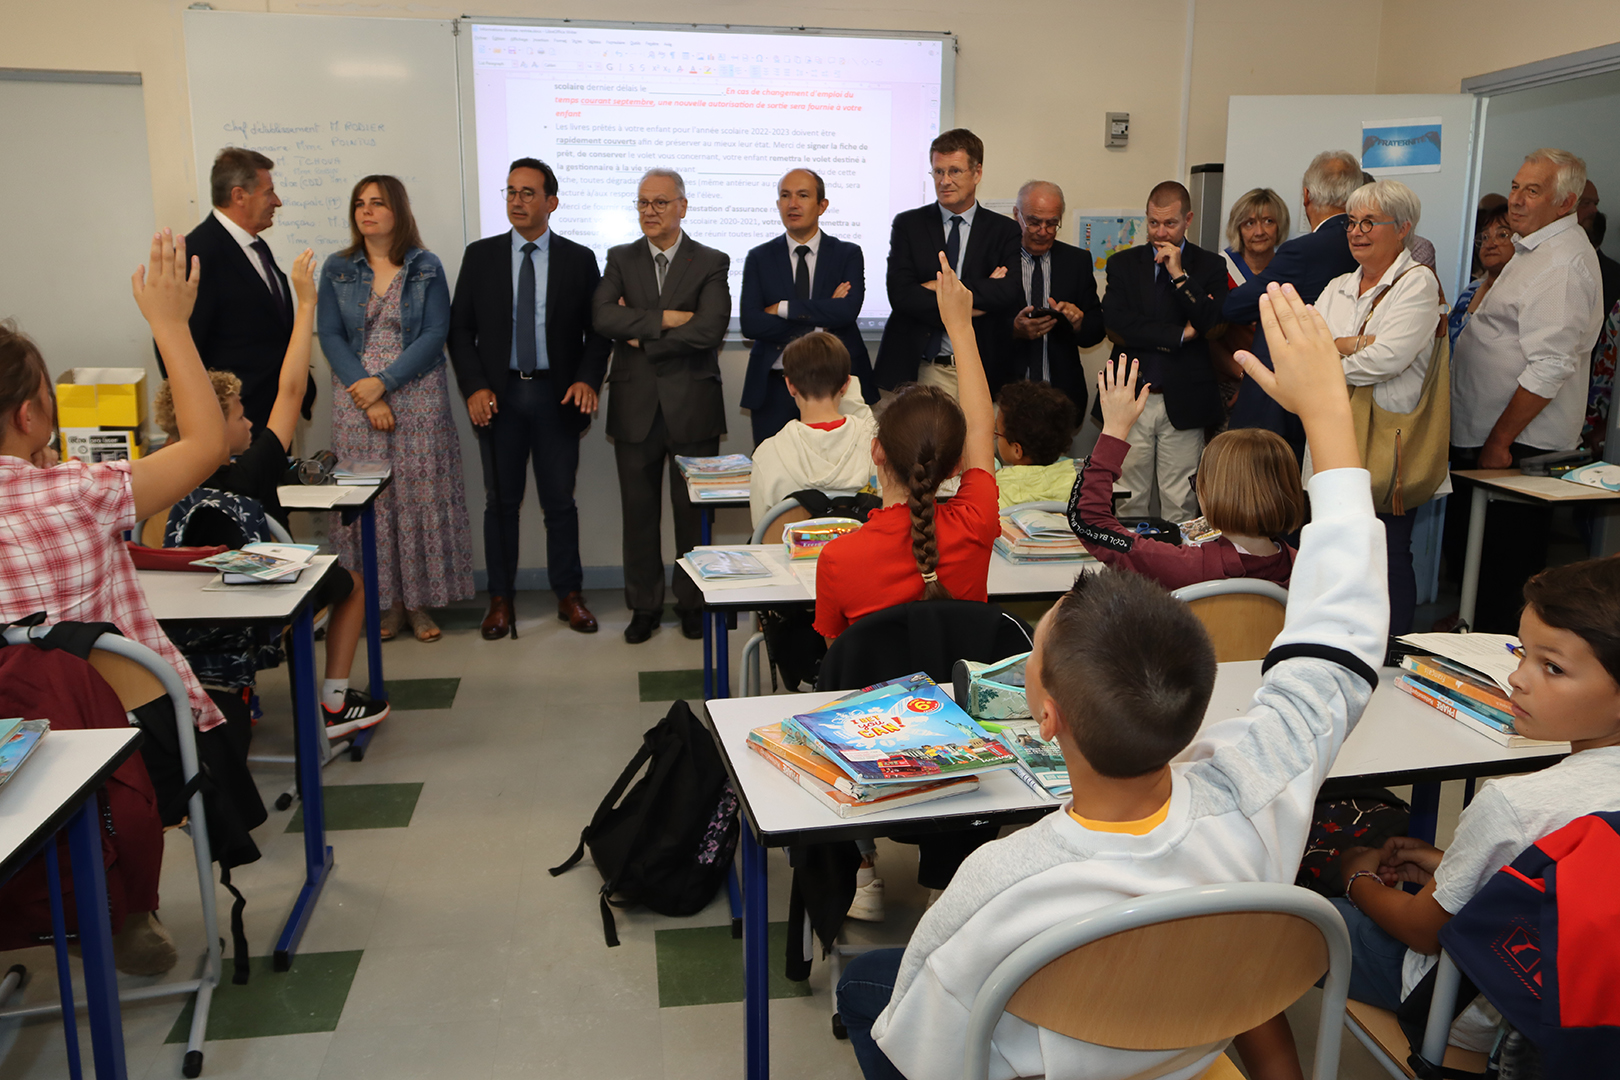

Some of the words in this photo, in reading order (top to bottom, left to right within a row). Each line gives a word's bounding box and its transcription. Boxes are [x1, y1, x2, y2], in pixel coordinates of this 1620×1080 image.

[554, 82, 585, 91] scolaire
[586, 83, 615, 92] dernier
[616, 83, 638, 92] délais
[639, 84, 647, 92] le
[726, 87, 735, 95] En
[751, 88, 761, 96] de
[762, 89, 809, 98] changement
[810, 90, 843, 99] d'emploi
[844, 91, 854, 99] du
[555, 97, 579, 105] temps
[581, 97, 611, 105] courant
[613, 97, 656, 107] septembre,
[674, 99, 707, 107] nouvelle
[708, 100, 754, 109] autorisation
[755, 101, 765, 109] de
[767, 101, 789, 109] sortie
[807, 102, 835, 112] fournie
[836, 103, 841, 111] à
[842, 104, 862, 112] votre
[555, 110, 582, 118] enfant
[555, 123, 569, 131] Les
[569, 123, 590, 132] livres
[591, 124, 616, 133] prêtés
[617, 124, 623, 132] à
[624, 125, 645, 133] votre
[646, 124, 671, 133] enfant
[672, 126, 691, 135] pour
[691, 126, 719, 135] l'année
[721, 127, 750, 135] scolaire
[751, 127, 790, 136] 2022-2023
[791, 128, 819, 137] doivent
[820, 128, 836, 137] être
[556, 137, 602, 145] rapidement
[603, 137, 637, 145] couverts
[638, 138, 652, 146] afin
[654, 138, 664, 146] de
[665, 139, 701, 148] préserver
[713, 140, 737, 148] mieux
[738, 140, 753, 148] leur
[773, 141, 794, 149] Merci
[796, 142, 806, 150] de
[807, 142, 829, 151] signer
[830, 142, 838, 150] la
[839, 142, 858, 150] fiche
[858, 143, 868, 151] de
[556, 149, 575, 159] prêt,
[576, 150, 587, 158] de
[628, 151, 635, 159] le
[636, 151, 656, 159] volet
[676, 153, 721, 161] concernant,
[744, 153, 768, 162] enfant
[769, 154, 802, 163] remettra
[803, 155, 811, 163] le
[812, 155, 831, 164] volet
[832, 155, 860, 164] destiné
[861, 156, 866, 164] à
[556, 162, 564, 170] la
[565, 163, 614, 172] gestionnaire
[615, 163, 620, 171] à
[621, 163, 629, 171] la
[630, 164, 642, 172] vie
[827, 168, 836, 176] de
[837, 169, 856, 177] cette
[580, 177, 605, 185] toutes
[606, 177, 639, 186] dégradat
[727, 179, 760, 187] antérieur
[824, 181, 844, 189] endu,
[687, 205, 723, 213] ttestation
[724, 205, 769, 213] d'assurance
[558, 216, 592, 224] couvrant
[689, 217, 718, 225] scolaire
[719, 218, 761, 227] 2020-2021,
[852, 232, 862, 240] de
[1436, 700, 1456, 718] PHARE
[857, 716, 906, 739] CAN!
